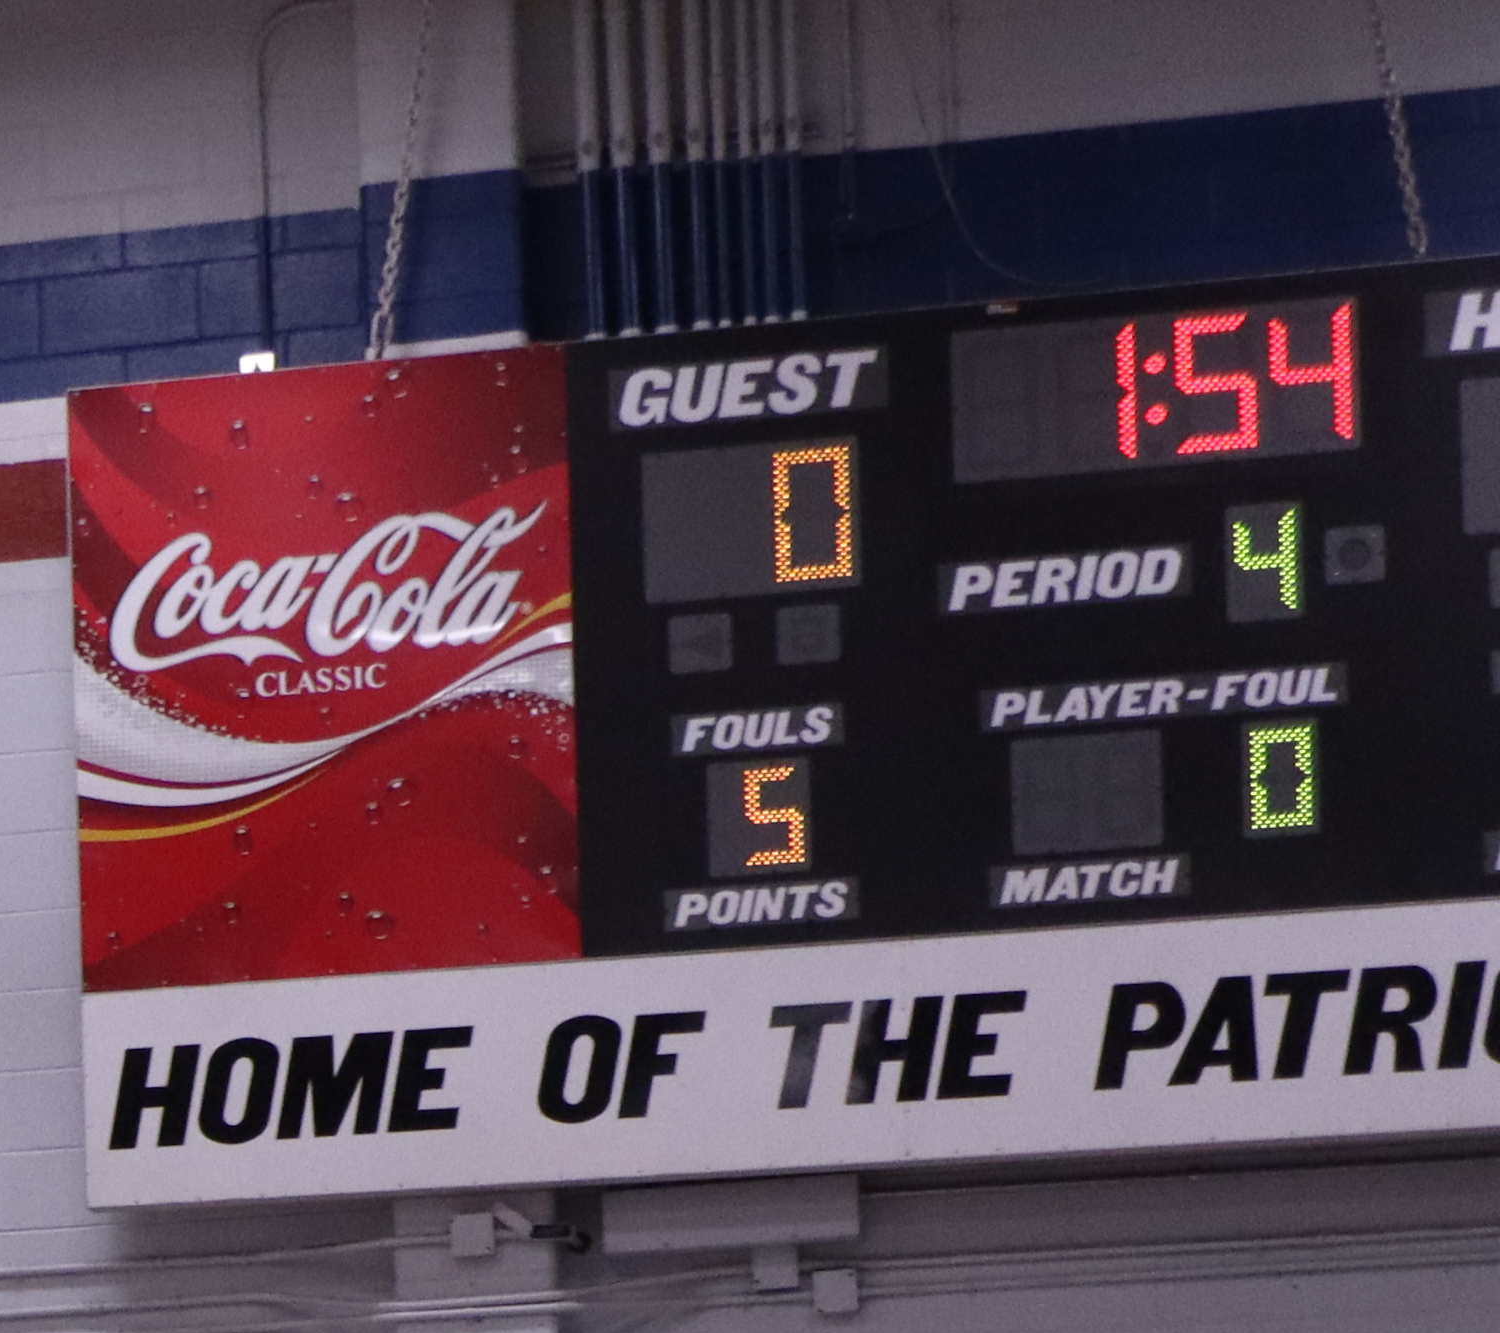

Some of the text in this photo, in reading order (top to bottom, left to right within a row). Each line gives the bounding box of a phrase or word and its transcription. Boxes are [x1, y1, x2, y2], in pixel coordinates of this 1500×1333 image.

[618, 349, 879, 427] GUEST
[1116, 302, 1355, 459] 1:54
[772, 445, 853, 583] 0
[1232, 507, 1299, 610] 4
[110, 500, 548, 672] Coca-Cola
[948, 547, 1183, 612] PERIOD
[255, 664, 388, 699] CLASSIC
[990, 667, 1338, 728] PLAYER-FOUL
[681, 705, 835, 753] FOULS
[743, 764, 806, 867] 5
[1248, 725, 1316, 831] 0
[674, 880, 849, 928] POINTS
[1000, 858, 1181, 905] MATCH
[108, 960, 1500, 1151] HOME OF THE PATRI
